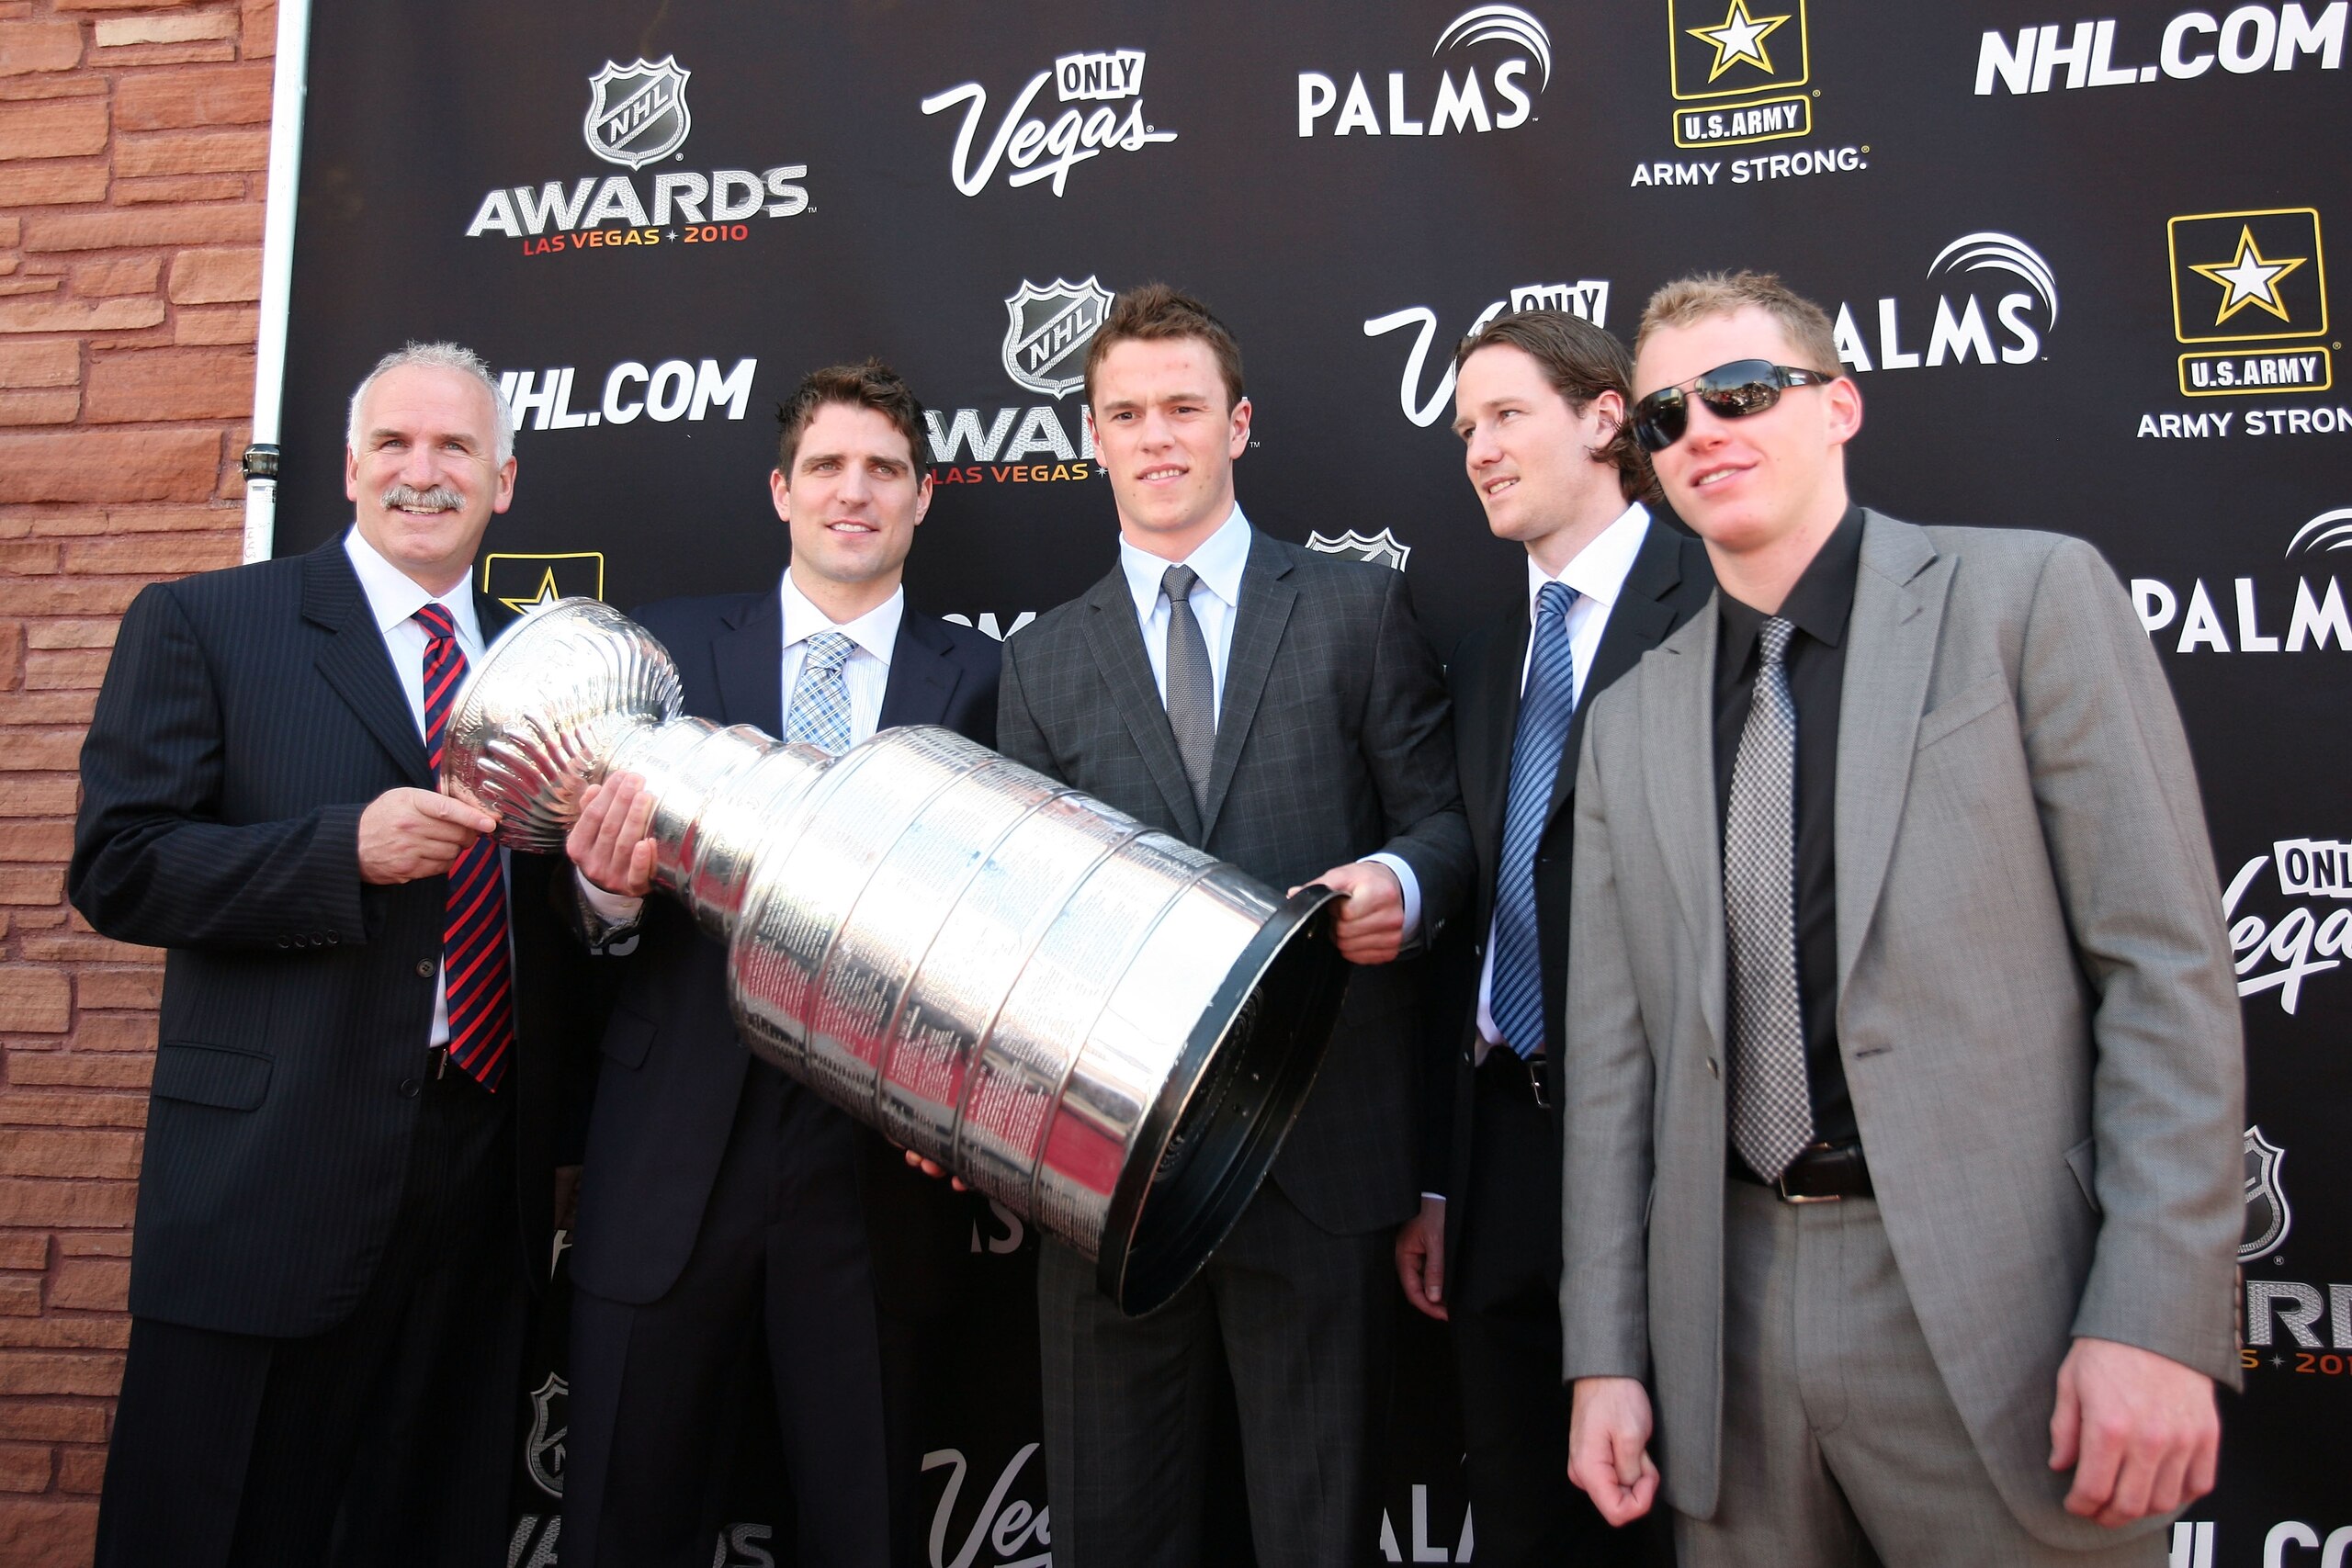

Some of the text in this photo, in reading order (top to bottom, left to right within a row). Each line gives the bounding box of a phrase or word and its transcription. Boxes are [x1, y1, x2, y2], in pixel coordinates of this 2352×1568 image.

[1062, 57, 1137, 94] ONLY
[1973, 1, 2349, 96] NHL.COM
[609, 84, 669, 143] NHL
[1297, 60, 1531, 138] PALMS
[921, 71, 1178, 197] Vegas
[1630, 147, 1868, 187] ARMY STRONG.
[464, 164, 809, 239] AWARDS
[522, 224, 749, 256] LAS VEGAS 2010
[1029, 306, 1093, 371] NHL
[1833, 293, 2040, 373] ALMS
[2136, 407, 2352, 438] ARMY STRON
[932, 463, 1090, 486] LAS VEGAS
[2130, 574, 2352, 653] PALM
[2284, 847, 2352, 889] ONL
